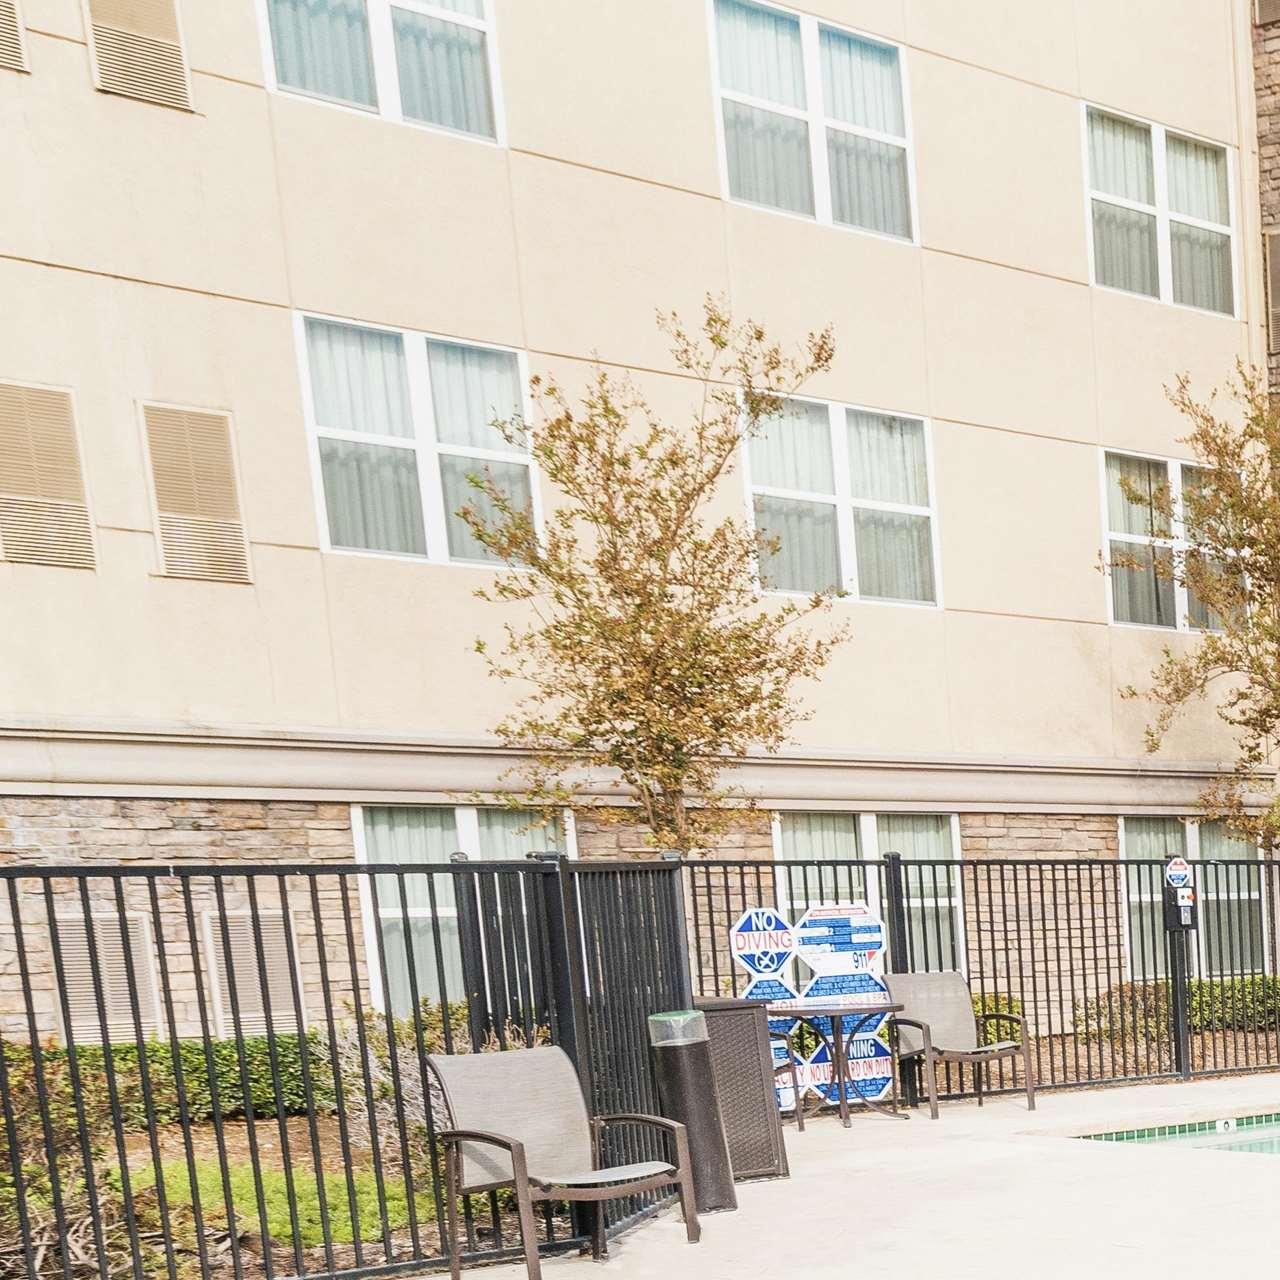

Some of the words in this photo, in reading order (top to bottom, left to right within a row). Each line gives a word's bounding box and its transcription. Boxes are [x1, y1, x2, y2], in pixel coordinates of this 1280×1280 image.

[751, 912, 776, 931] NO
[735, 930, 793, 951] DIVING
[852, 952, 869, 969] 911
